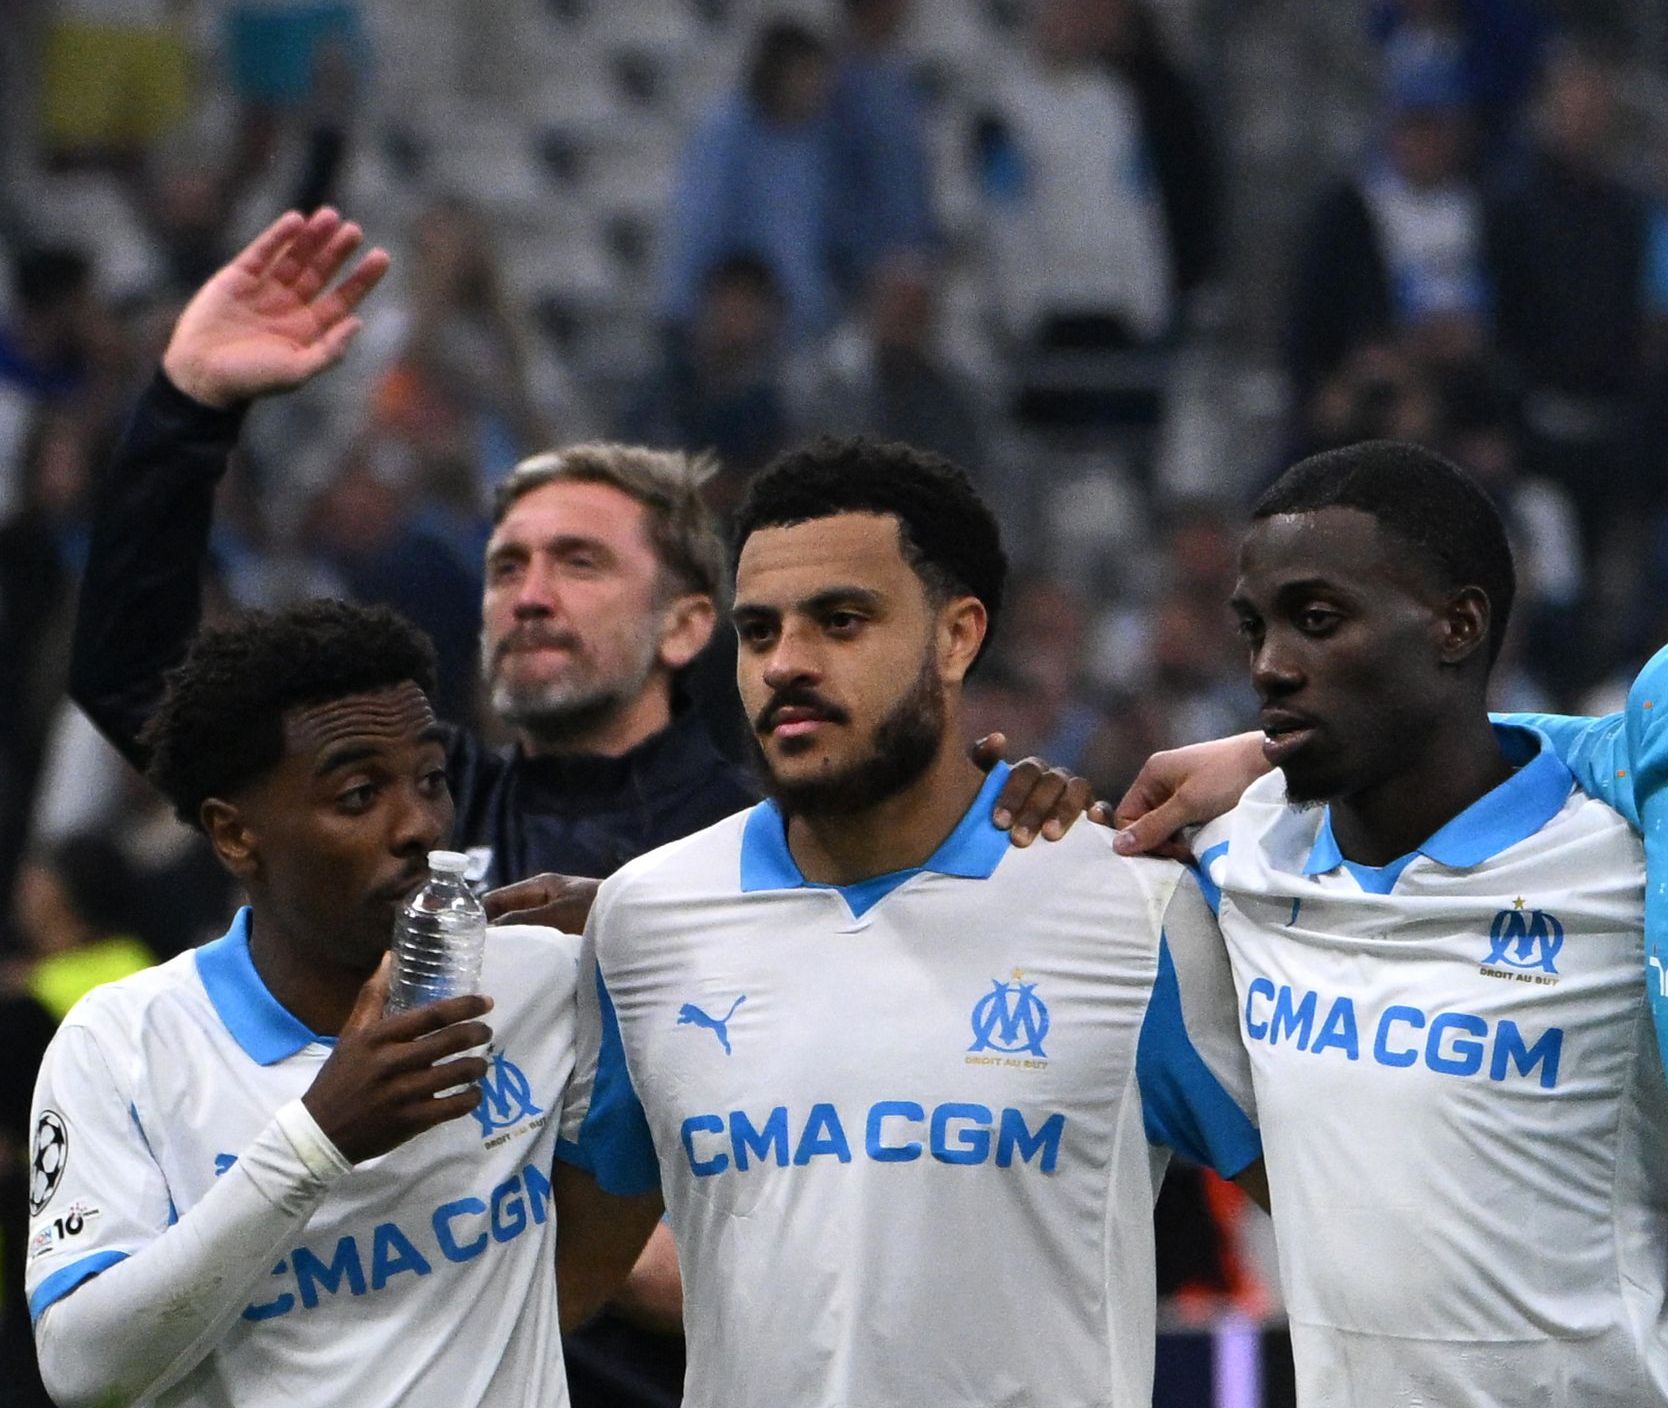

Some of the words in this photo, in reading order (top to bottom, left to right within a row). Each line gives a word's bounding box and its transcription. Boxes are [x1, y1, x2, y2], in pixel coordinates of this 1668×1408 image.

[1479, 967, 1514, 980] DROIT
[1515, 974, 1532, 983] AU
[1535, 976, 1560, 987] BUT
[1245, 977, 1359, 1060] CMA
[1373, 1005, 1564, 1088] CGM
[485, 1133, 511, 1150] DROIT
[681, 1104, 851, 1177] CMA
[866, 1101, 1065, 1173] CGM
[54, 1214, 84, 1240] 10
